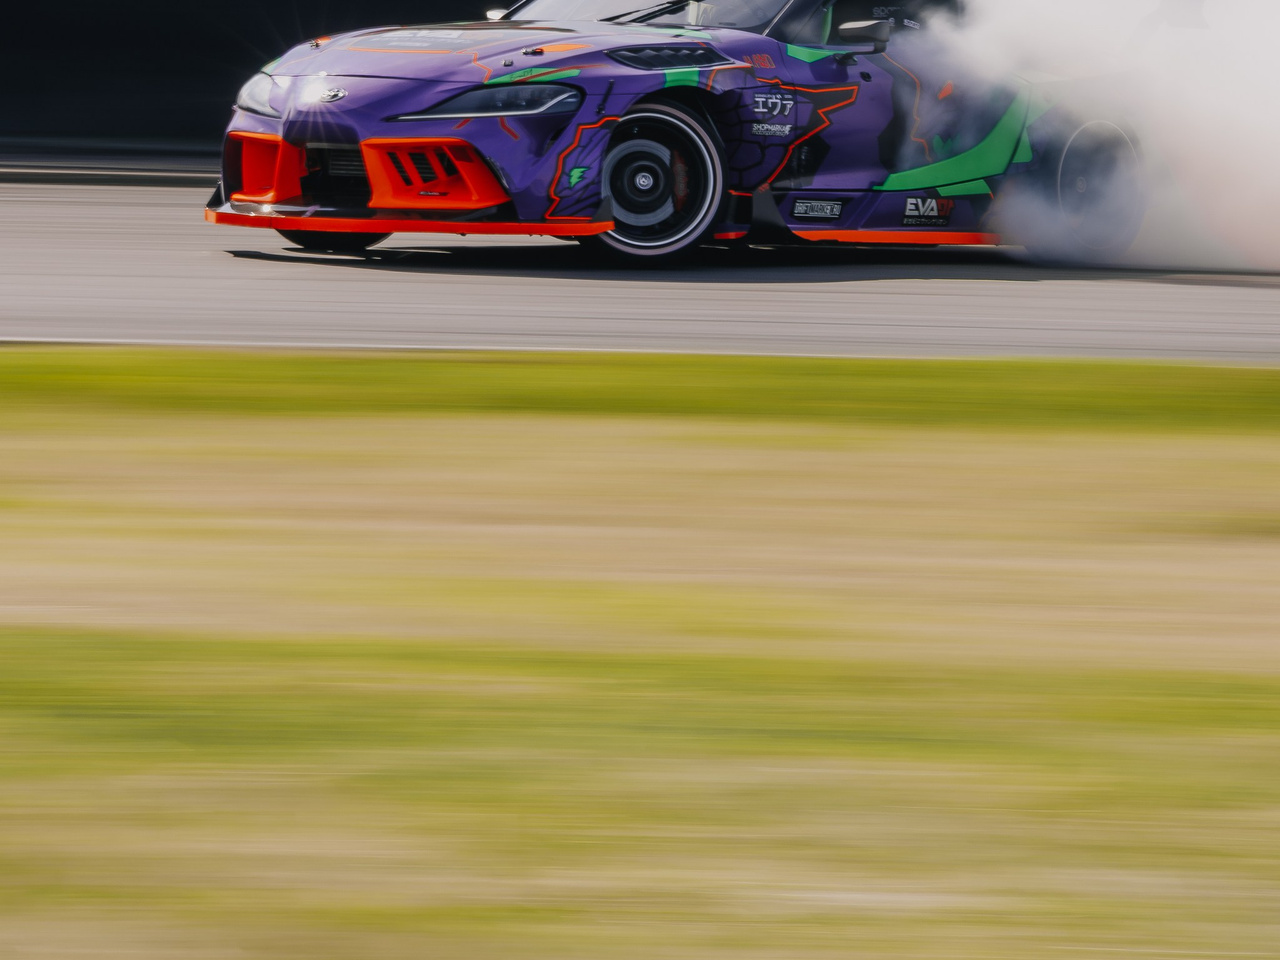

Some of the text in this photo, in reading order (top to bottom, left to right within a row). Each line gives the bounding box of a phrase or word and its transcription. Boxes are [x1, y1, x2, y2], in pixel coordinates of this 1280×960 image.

[753, 94, 794, 116] エヴァ
[904, 198, 939, 216] EVA
